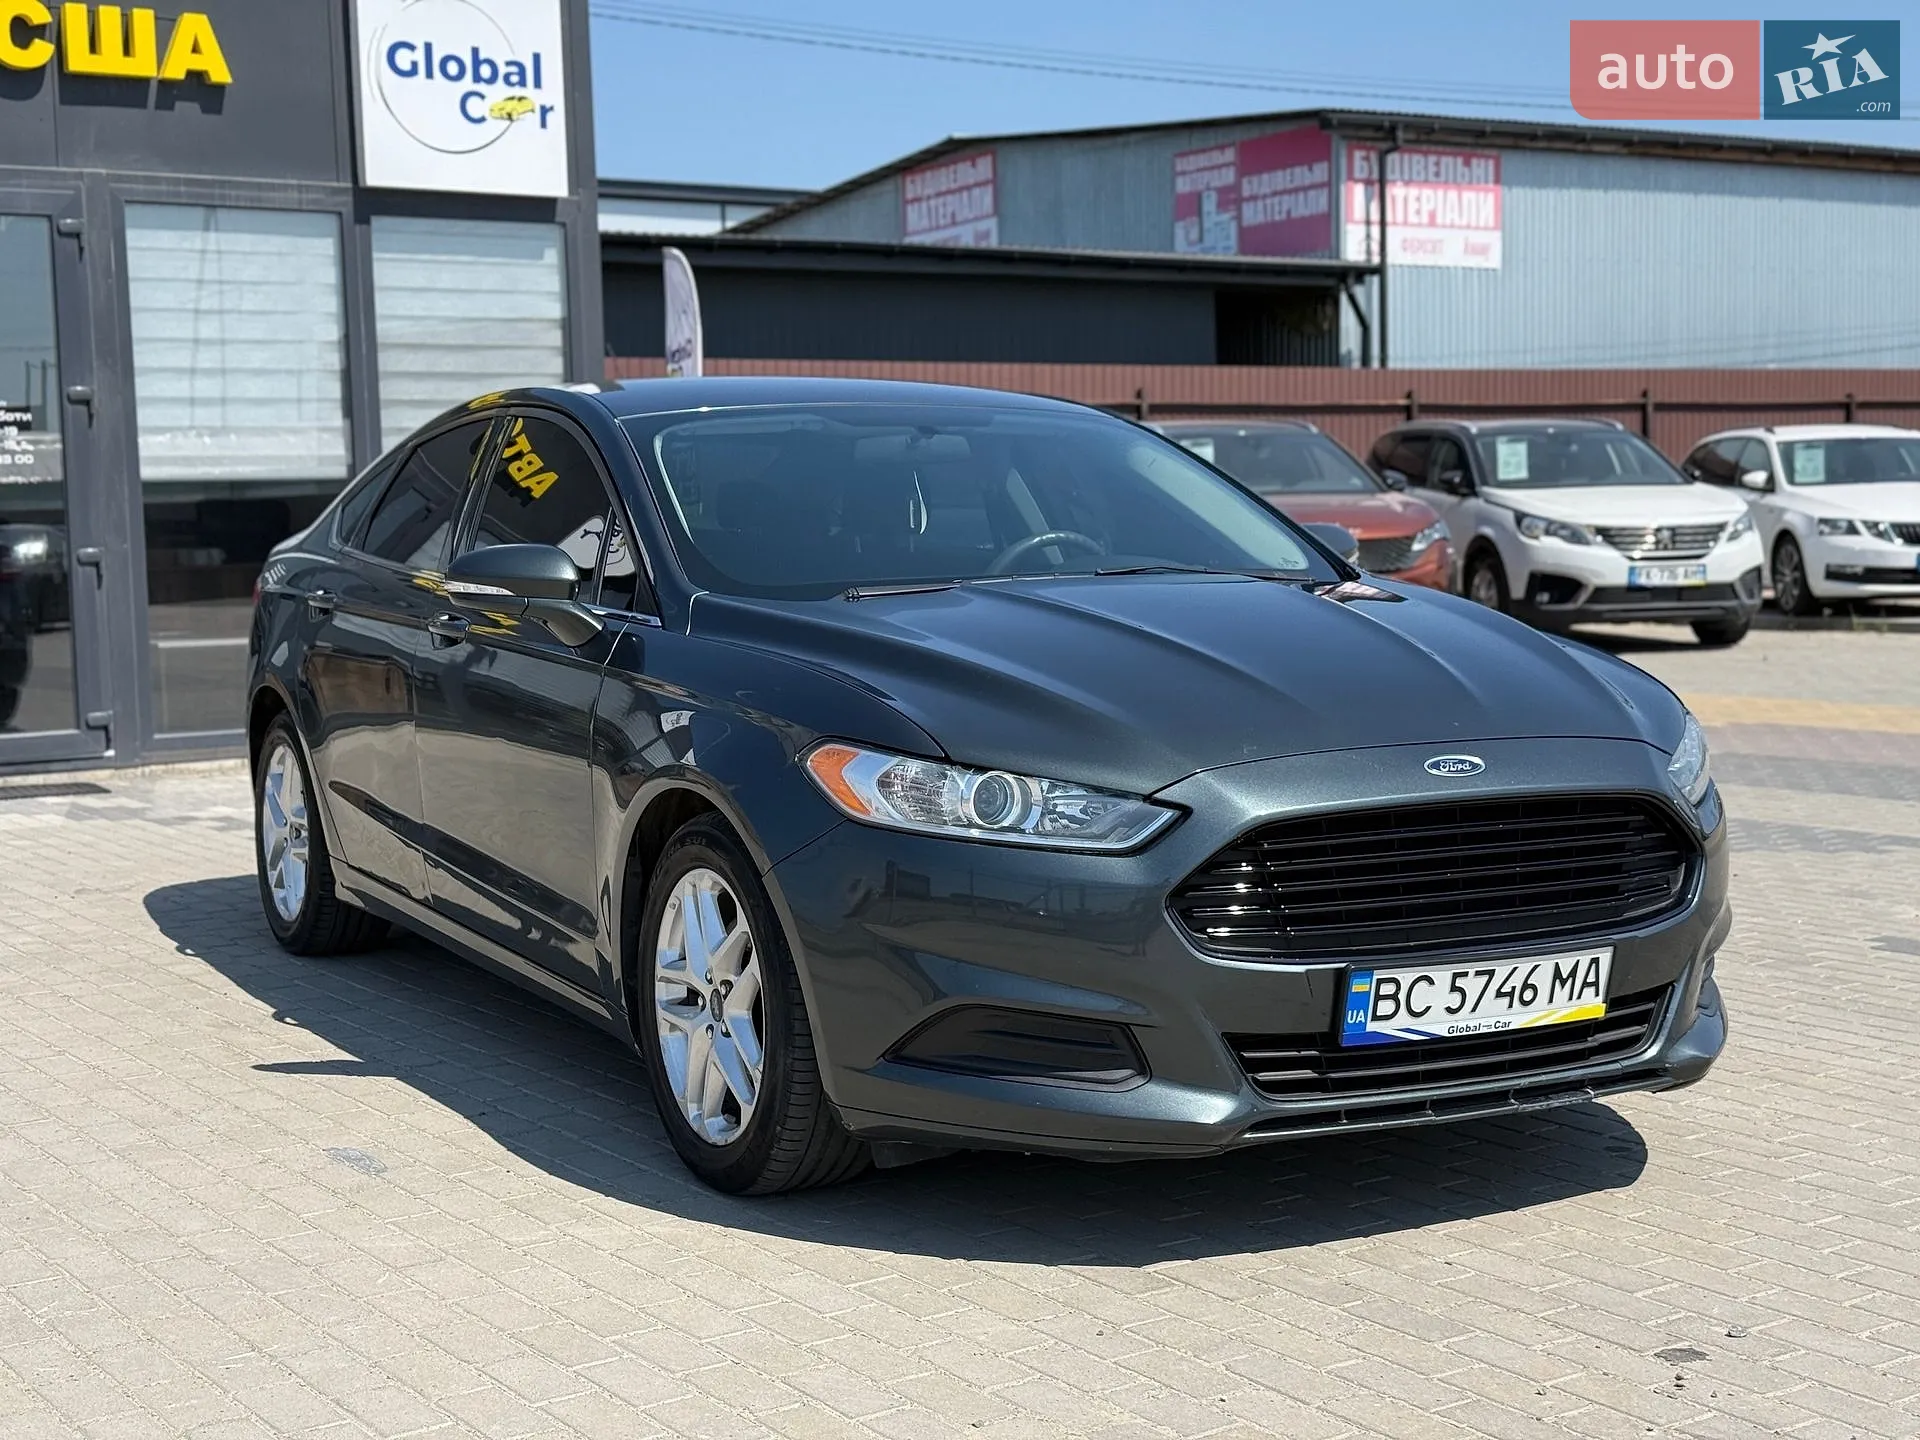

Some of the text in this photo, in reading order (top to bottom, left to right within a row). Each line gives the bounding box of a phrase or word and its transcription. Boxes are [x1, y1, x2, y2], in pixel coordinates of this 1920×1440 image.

[0, 0, 233, 85] США
[386, 40, 542, 89] Global
[459, 90, 554, 129] Cr
[1440, 760, 1472, 772] Ford
[1370, 956, 1601, 1023] BC 5746 MA
[1347, 1010, 1366, 1024] UA
[1447, 1023, 1481, 1035] Global
[1494, 1020, 1512, 1030] Car
